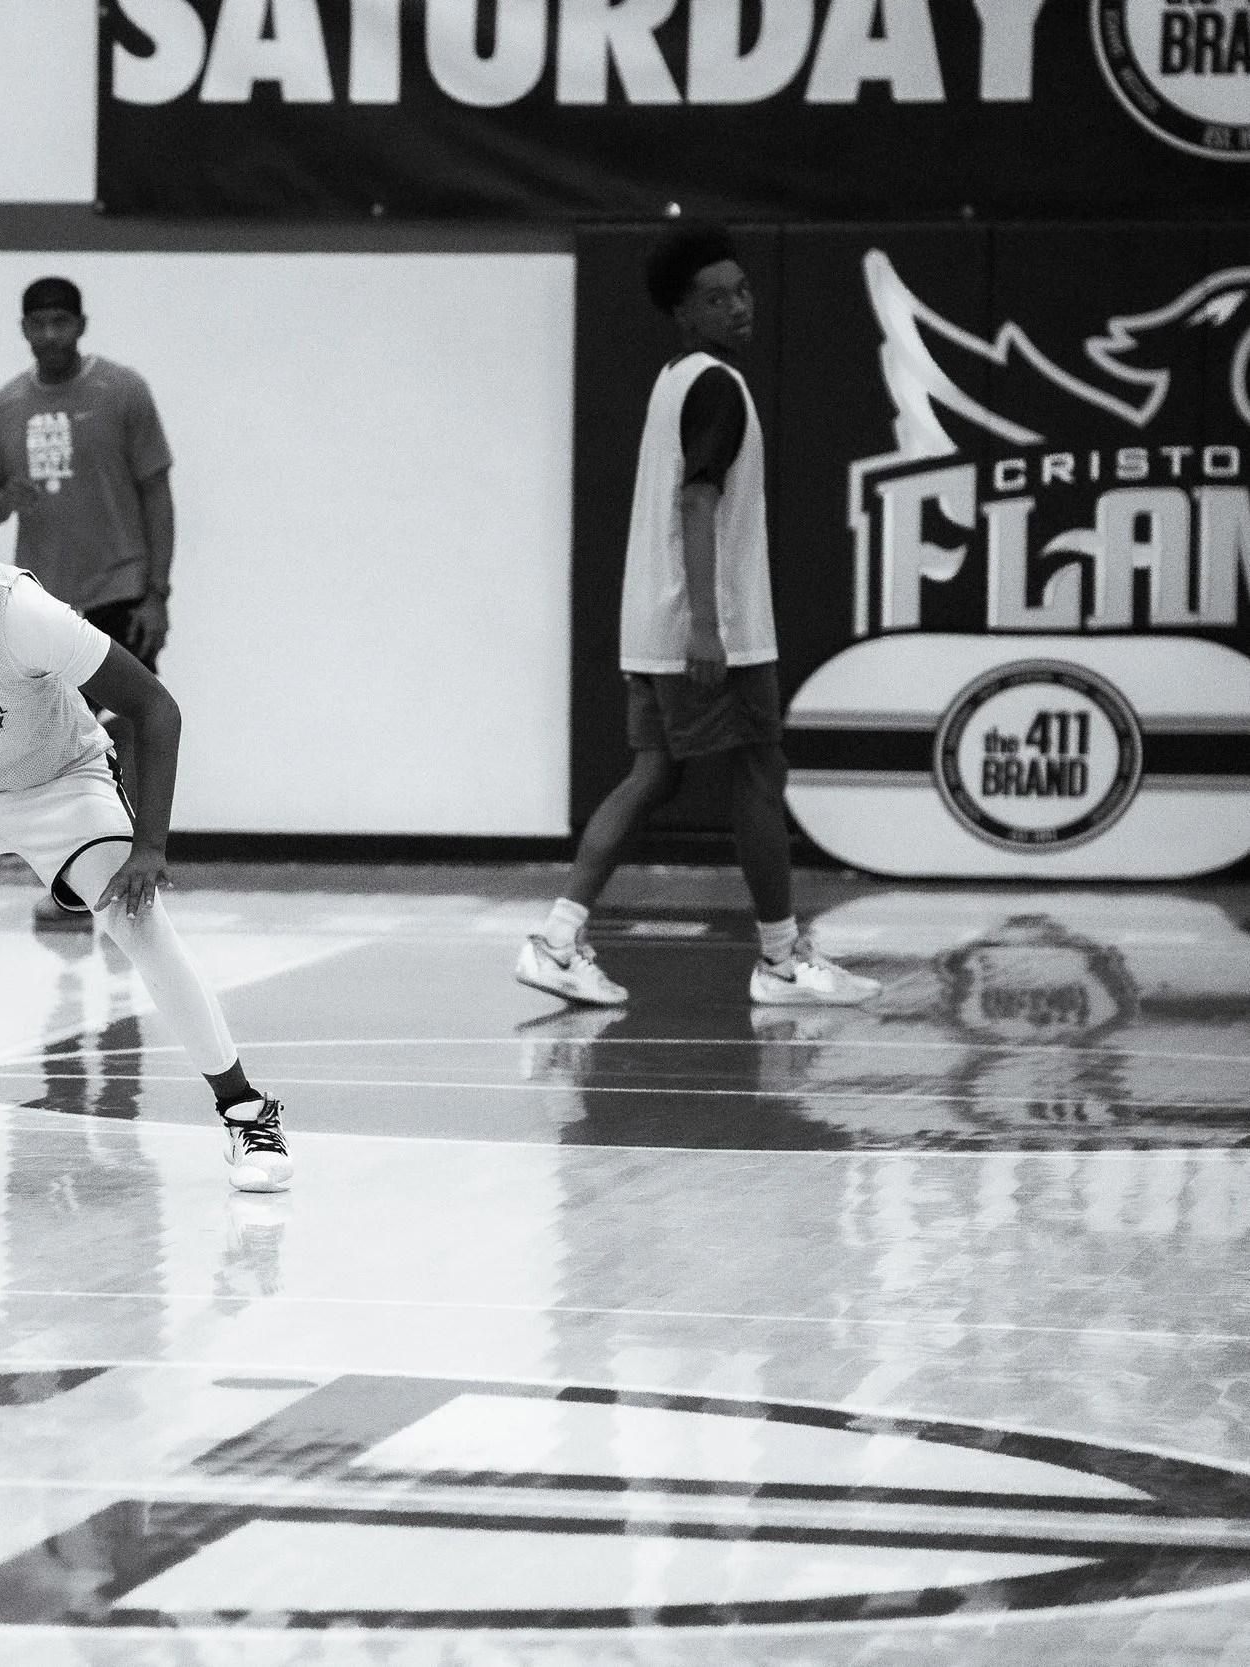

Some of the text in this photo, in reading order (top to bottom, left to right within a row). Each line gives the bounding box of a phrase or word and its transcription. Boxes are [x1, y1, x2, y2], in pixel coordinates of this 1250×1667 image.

[993, 444, 1240, 492] CRISTO
[983, 710, 1091, 755] the 411
[981, 757, 1089, 798] BRAND
